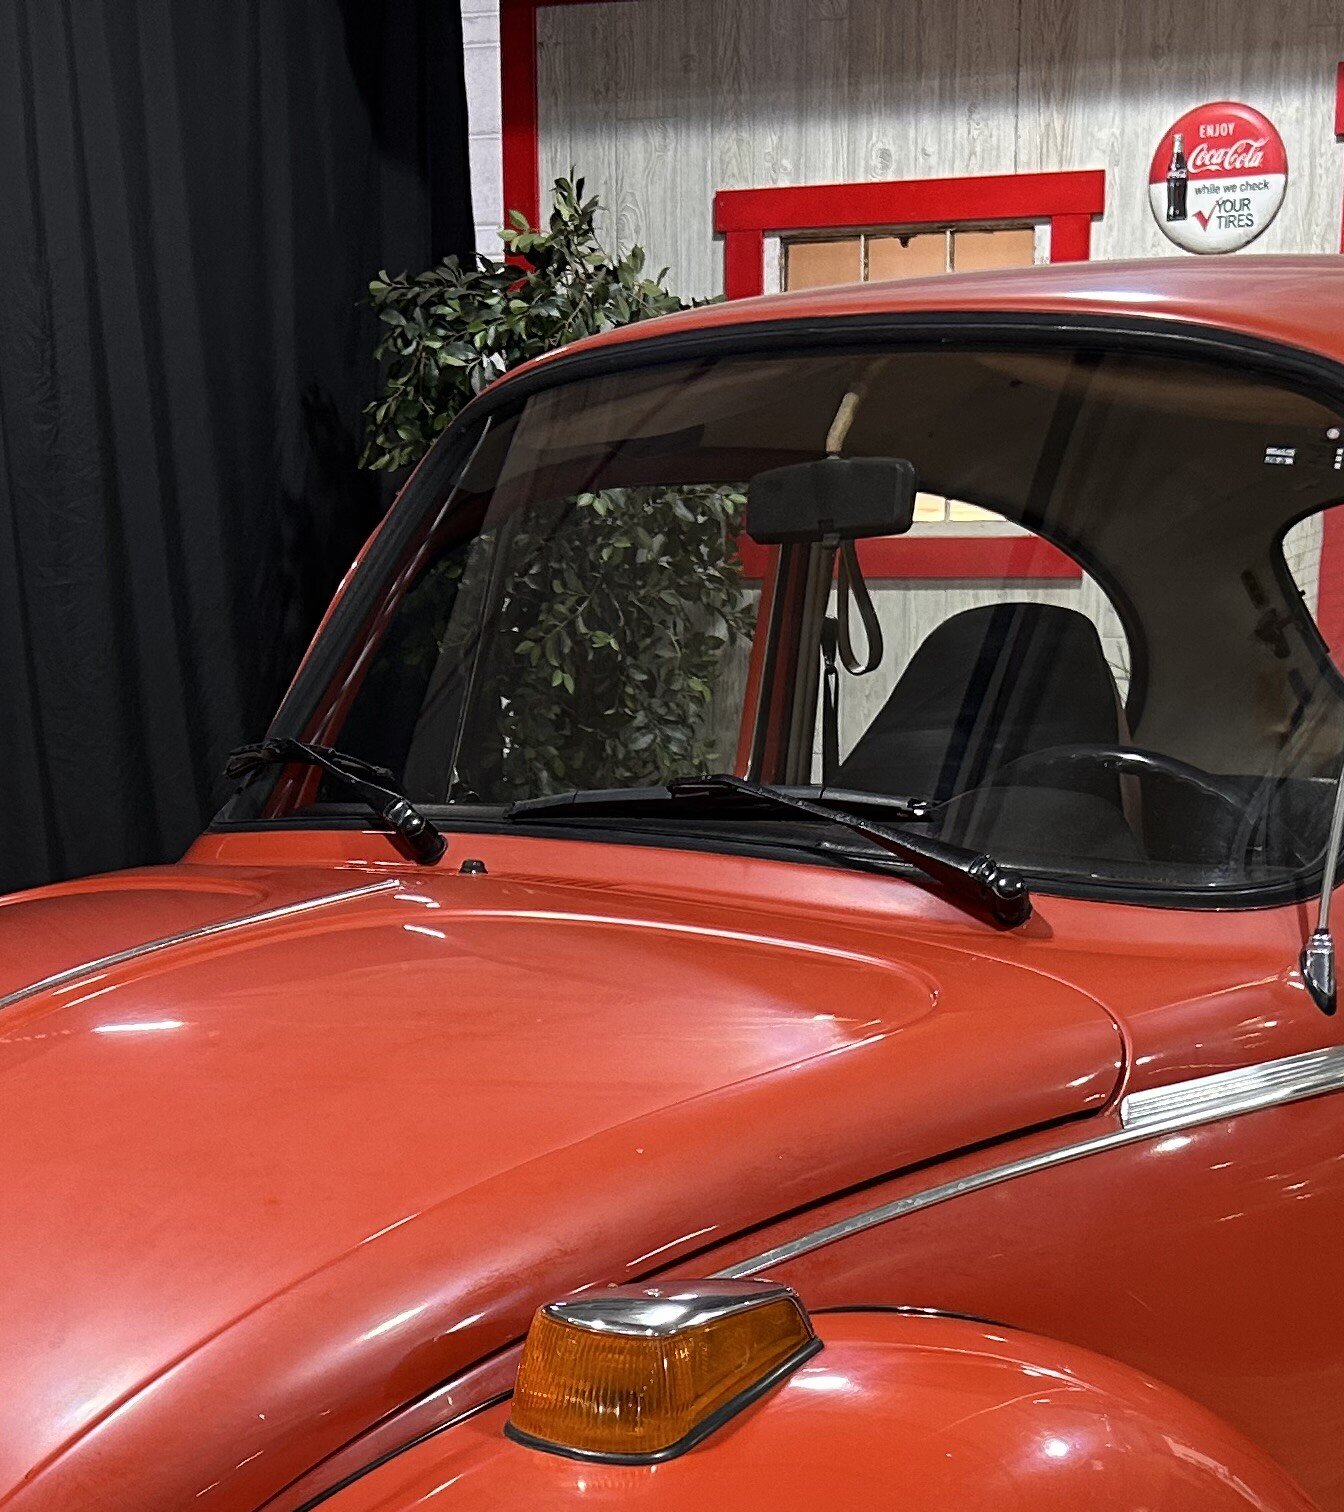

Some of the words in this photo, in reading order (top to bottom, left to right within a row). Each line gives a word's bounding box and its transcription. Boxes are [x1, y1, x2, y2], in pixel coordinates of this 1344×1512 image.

[1199, 122, 1235, 138] ENJOY
[1195, 184, 1221, 195] while
[1223, 184, 1237, 193] we
[1239, 179, 1269, 192] check
[1216, 197, 1251, 214] YOUR
[1216, 213, 1254, 229] TIRES
